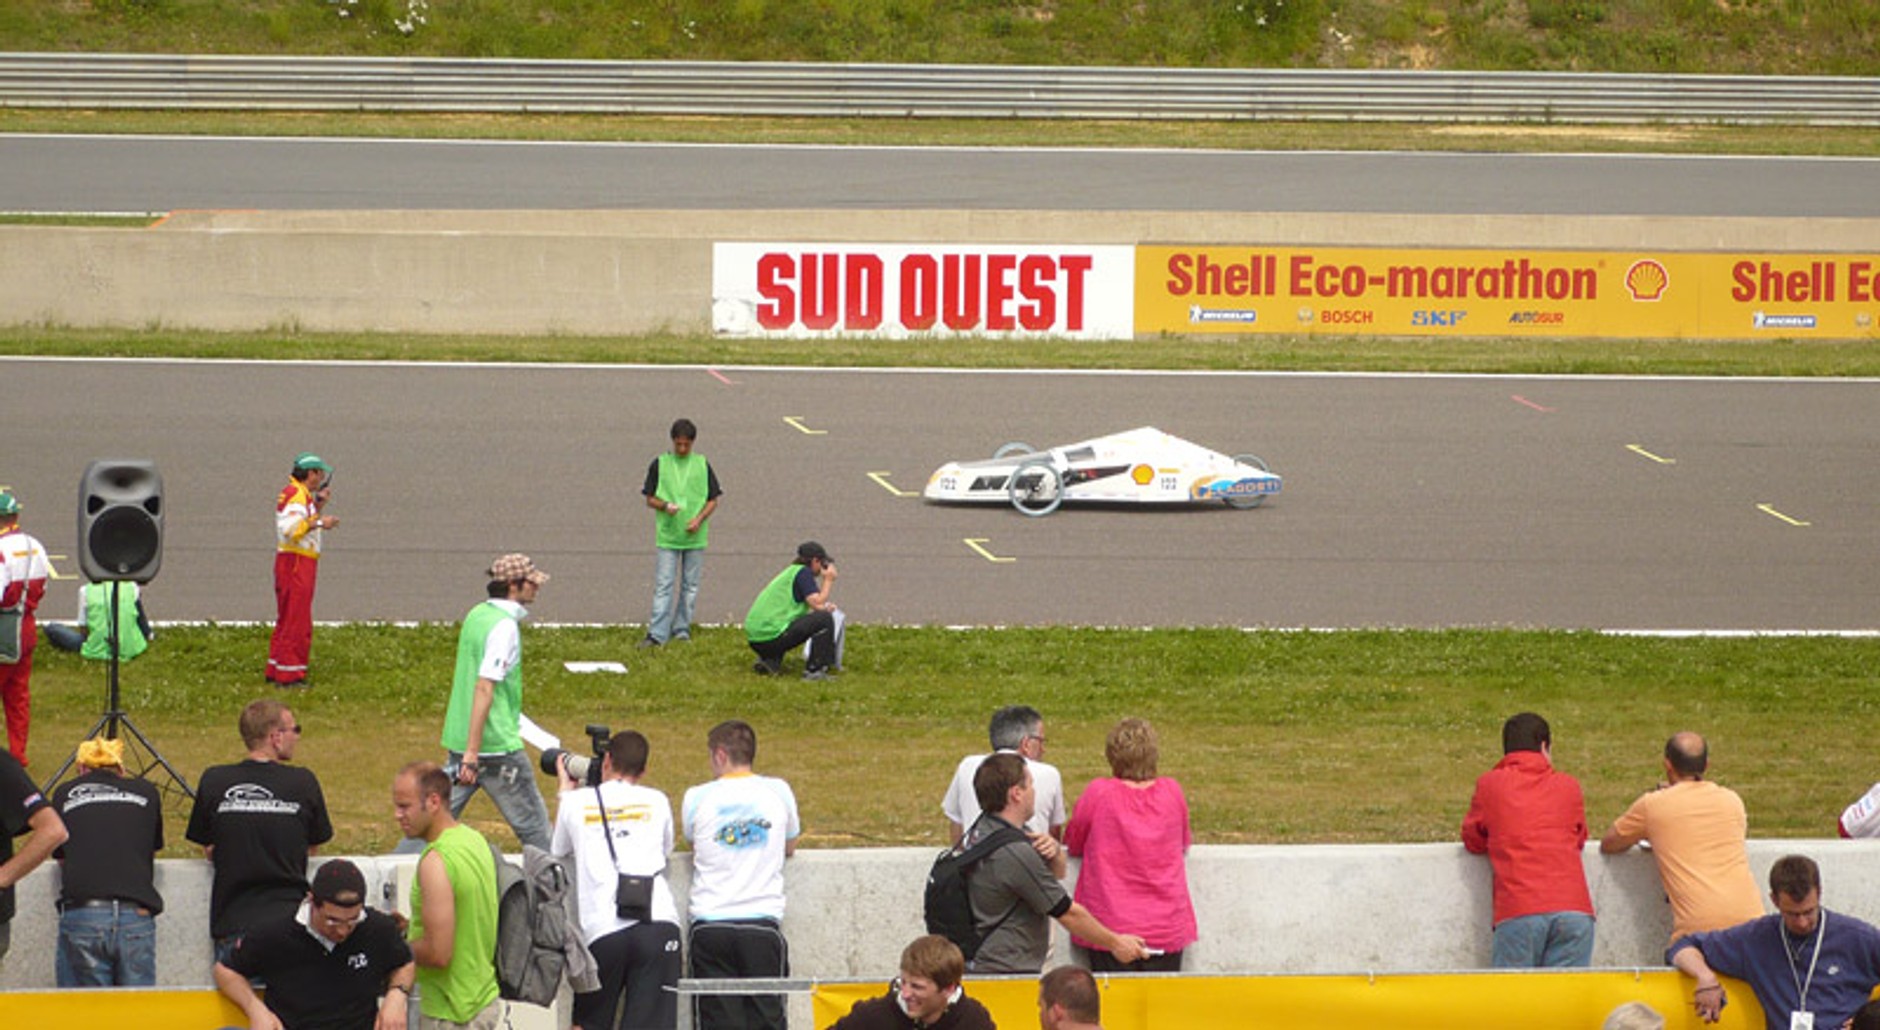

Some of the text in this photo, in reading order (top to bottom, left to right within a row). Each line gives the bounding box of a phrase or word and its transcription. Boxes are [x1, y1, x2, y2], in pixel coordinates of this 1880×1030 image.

[756, 252, 1092, 332] SUD OUEST
[1166, 253, 1598, 301] Shell Eco-marathon
[1731, 260, 1836, 302] Shell
[1321, 310, 1373, 324] BOSCH
[1410, 310, 1468, 326] SKF
